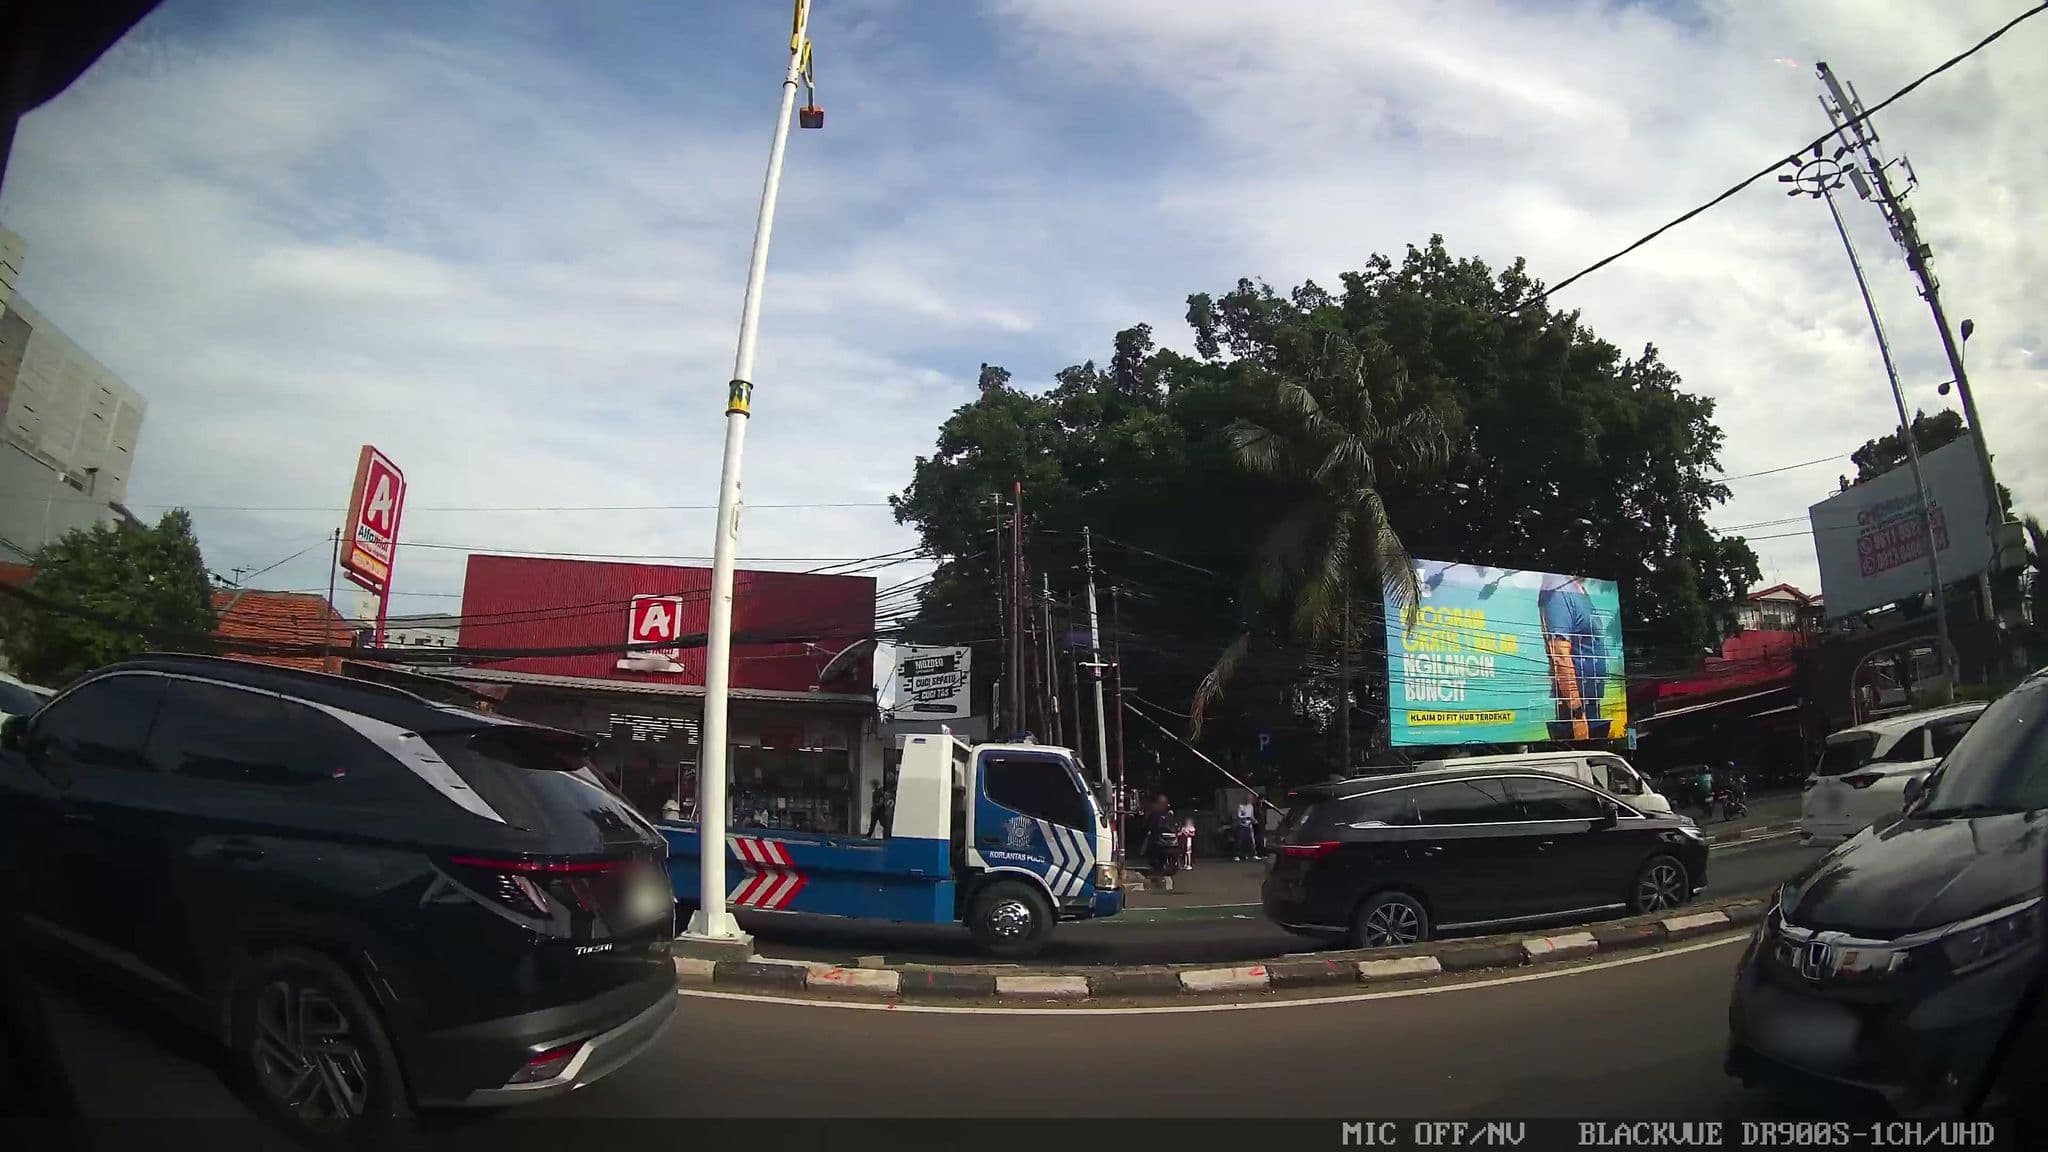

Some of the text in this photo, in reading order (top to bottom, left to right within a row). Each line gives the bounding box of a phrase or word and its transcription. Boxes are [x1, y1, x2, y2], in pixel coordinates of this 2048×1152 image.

[368, 474, 392, 530] A
[640, 602, 670, 637] A
[916, 678, 932, 687] CUCI
[937, 688, 950, 697] TAS
[1405, 678, 1467, 702] BUNCIT
[1410, 714, 1436, 722] KLAIM
[1446, 713, 1458, 721] FIT
[1459, 713, 1474, 721] HUB
[1475, 713, 1512, 721] TERDEKAT
[1259, 734, 1270, 751] P
[989, 851, 1026, 861] KORLANTAS
